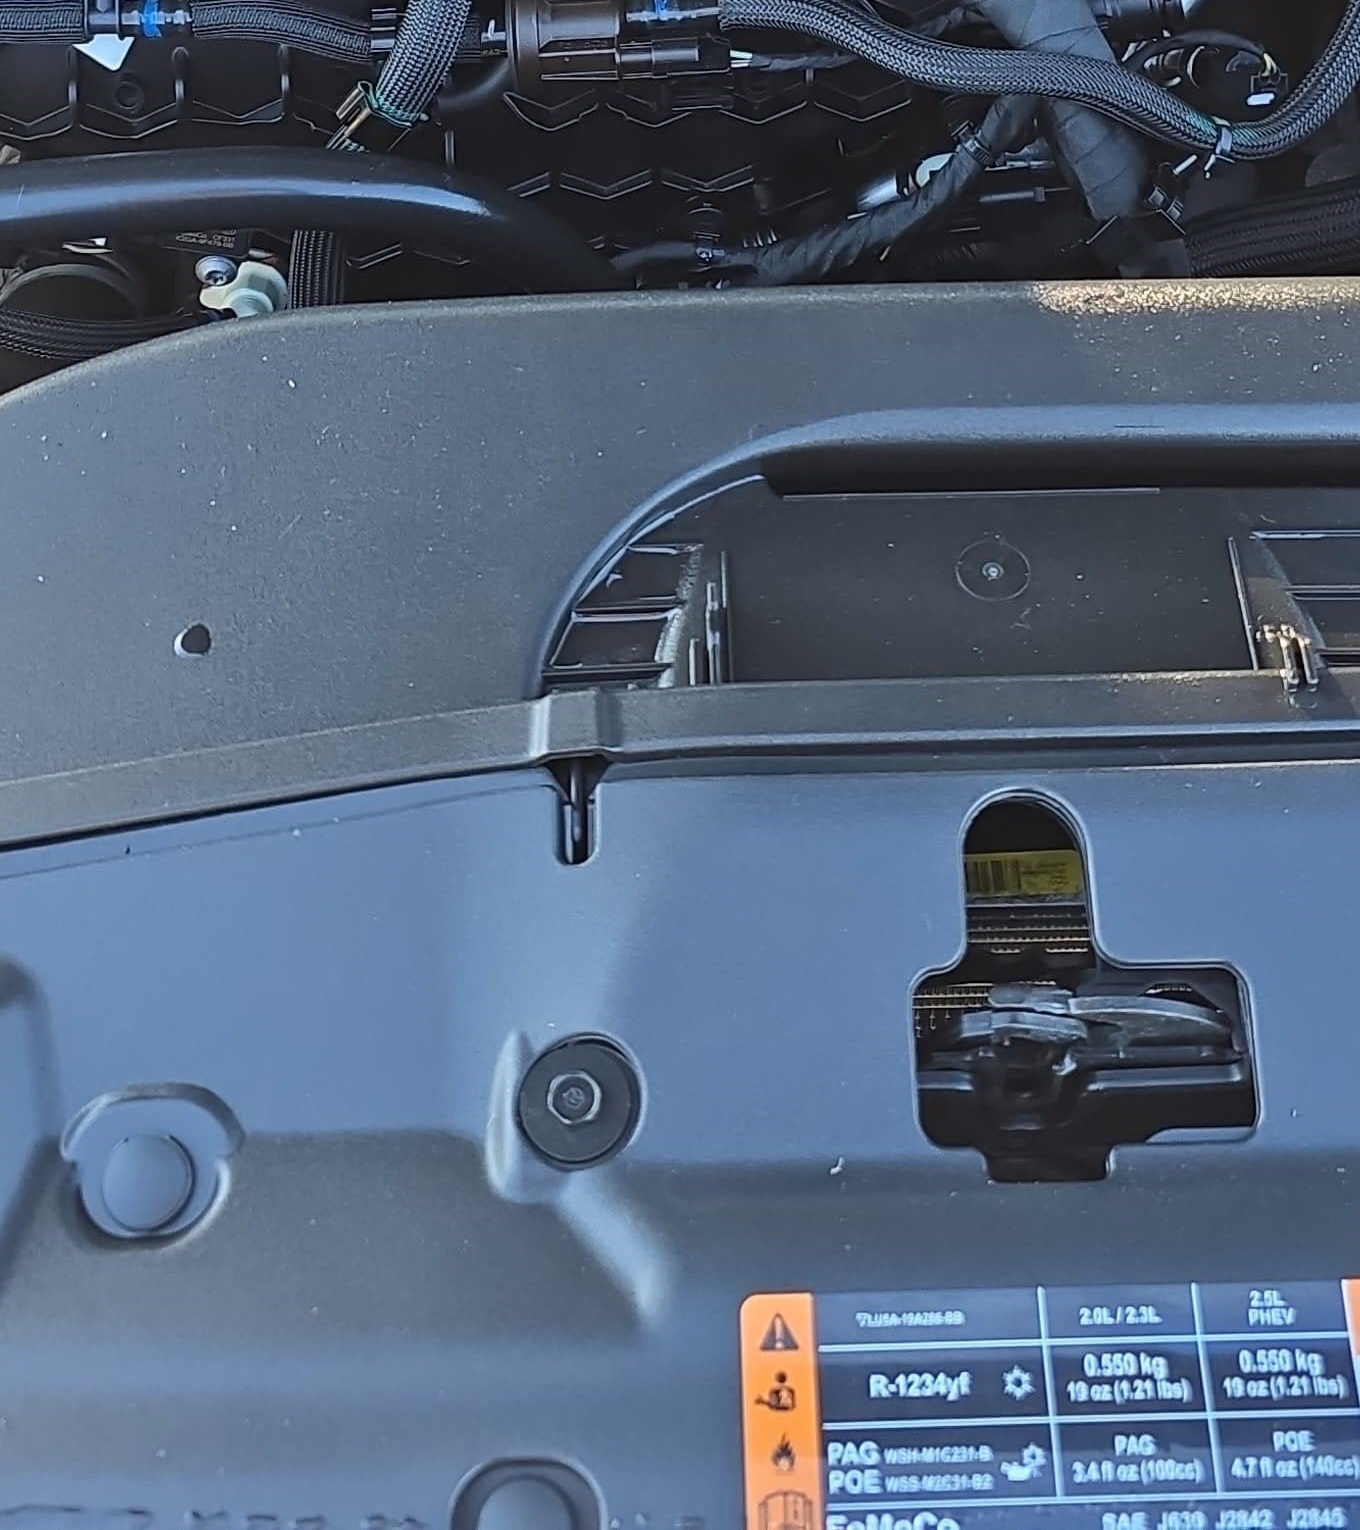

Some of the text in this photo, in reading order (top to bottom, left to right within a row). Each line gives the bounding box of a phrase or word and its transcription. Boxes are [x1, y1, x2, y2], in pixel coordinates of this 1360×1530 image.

[1249, 1290, 1288, 1308] 2.5L
[1079, 1307, 1115, 1325] 2.0L
[1125, 1306, 1163, 1324] 2.3L
[1248, 1307, 1297, 1326] PHEV
[1083, 1351, 1169, 1379] 0.550 kg
[1239, 1348, 1326, 1376] 0.550 kg
[869, 1371, 972, 1401] R-1234yf
[1067, 1378, 1192, 1405] 19 oz (1.21 lbs)
[1223, 1374, 1349, 1401] 19 oz (1.21 lbs)
[1114, 1434, 1156, 1456] PAG
[1273, 1430, 1317, 1452] POE
[827, 1441, 881, 1466] PAG
[1116, 1463, 1139, 1482] oz
[1140, 1458, 1205, 1485] (100cc)
[1231, 1457, 1259, 1478] 4.7
[1275, 1460, 1298, 1477] oz
[829, 1470, 884, 1494] POE
[1102, 1511, 1149, 1530] SAE
